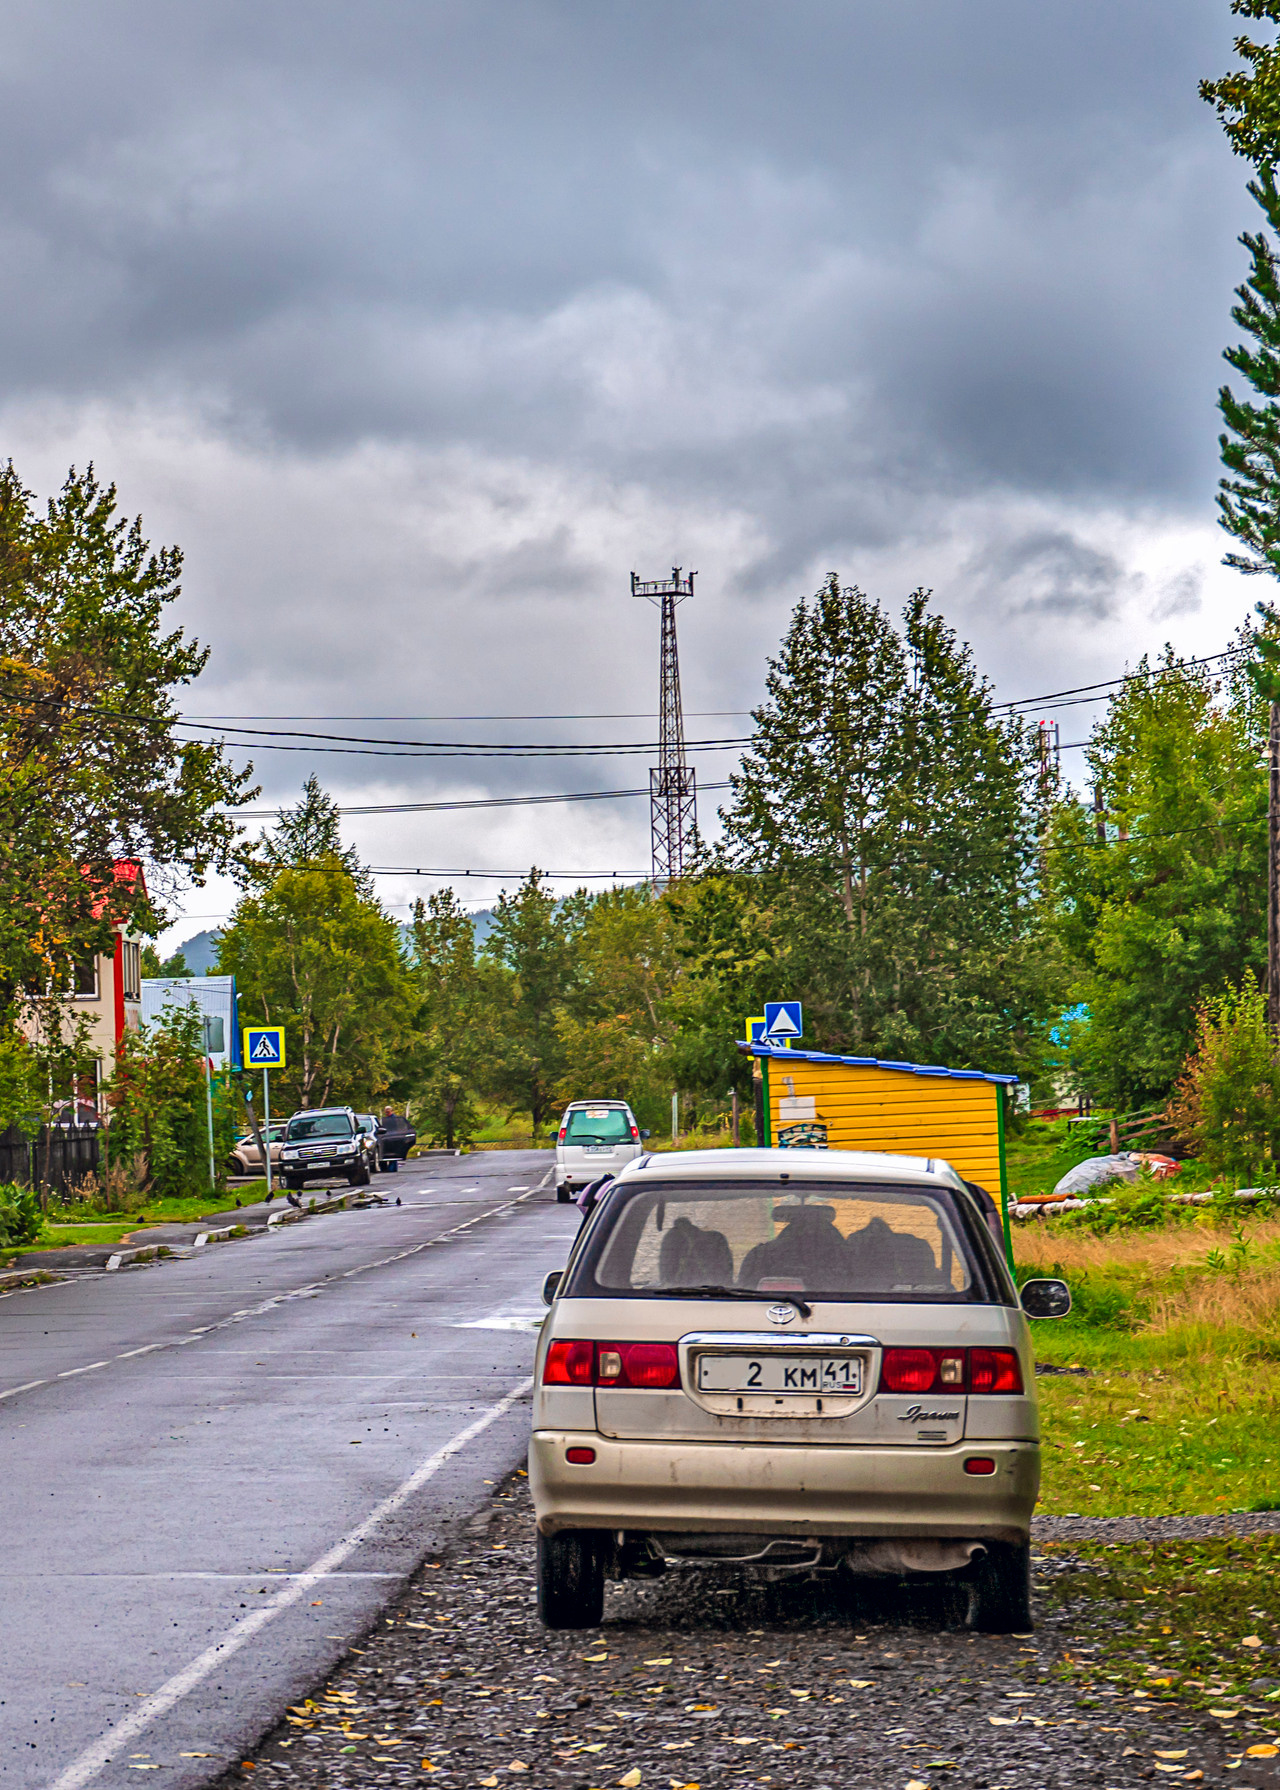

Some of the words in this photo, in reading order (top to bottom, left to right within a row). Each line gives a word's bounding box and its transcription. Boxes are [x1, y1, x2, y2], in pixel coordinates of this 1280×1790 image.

[747, 1361, 762, 1387] 2
[784, 1367, 817, 1388] KM
[824, 1361, 850, 1381] 41
[822, 1381, 842, 1389] RUS
